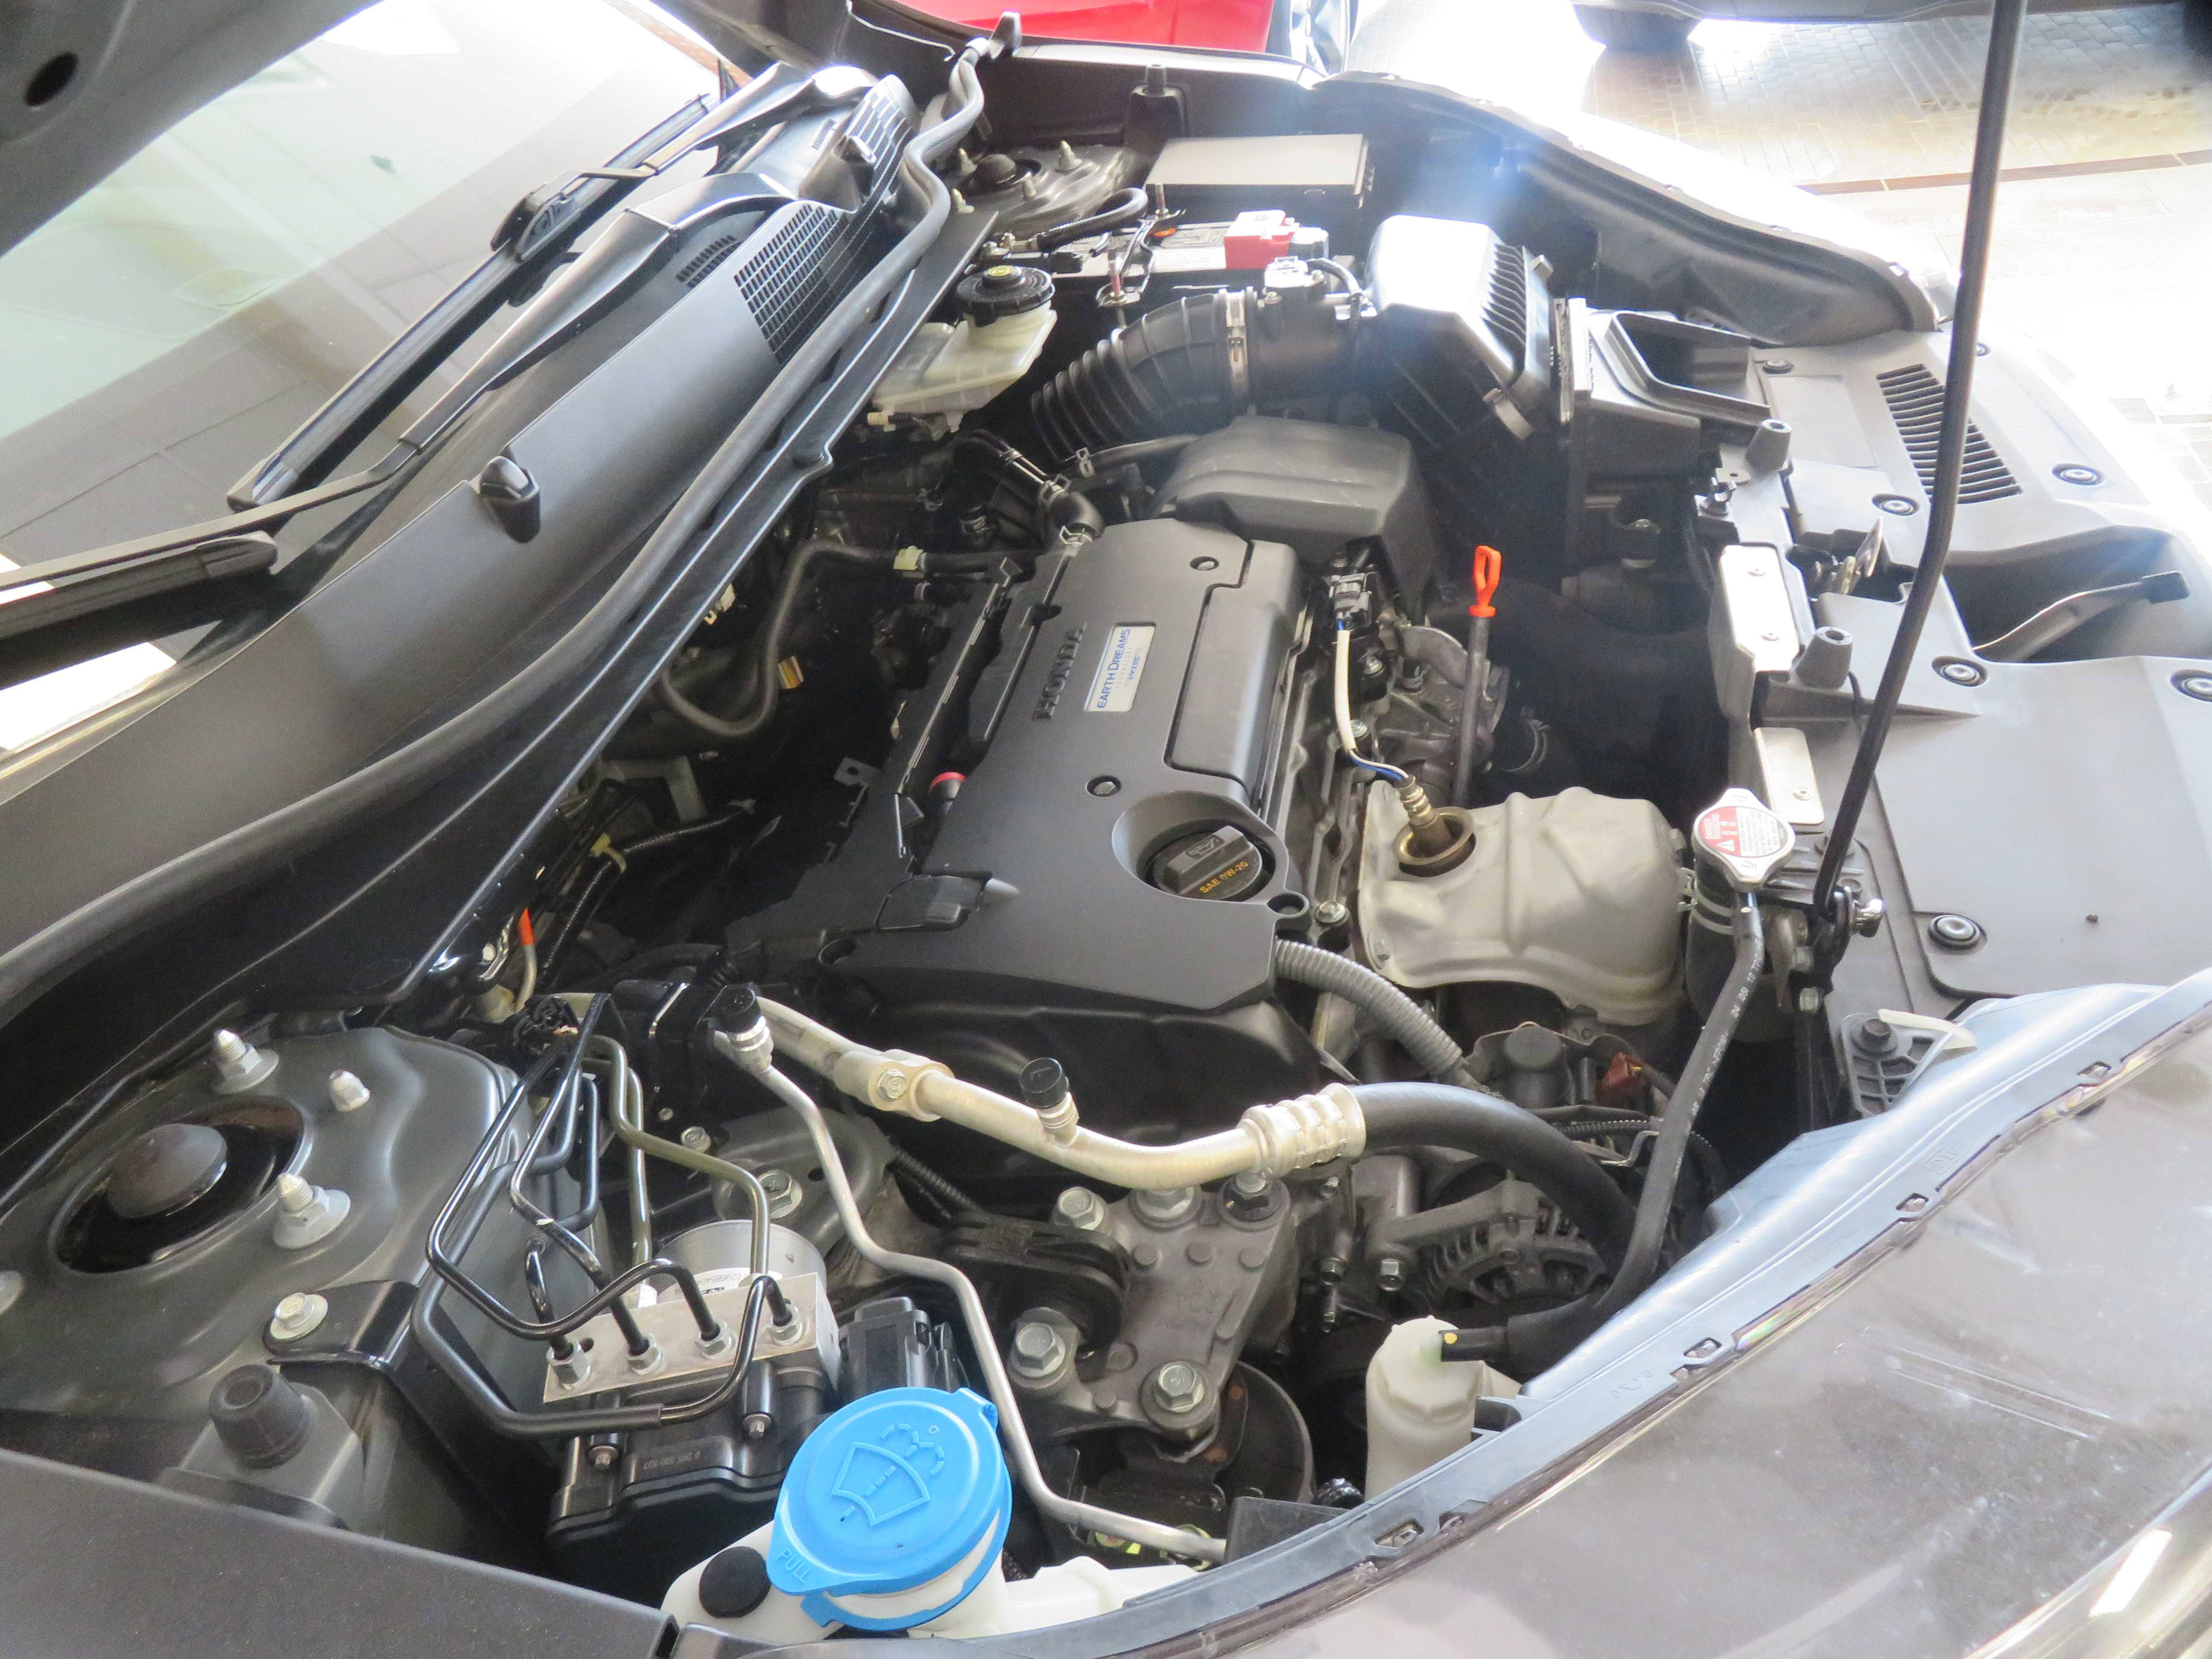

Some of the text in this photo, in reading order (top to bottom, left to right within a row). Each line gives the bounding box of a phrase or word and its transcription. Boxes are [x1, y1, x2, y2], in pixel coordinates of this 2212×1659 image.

[1032, 622, 1087, 720] HONDA
[1097, 629, 1130, 708] EARTH DREAMS
[1200, 878, 1221, 893] SAE
[776, 1548, 811, 1583] PULL
